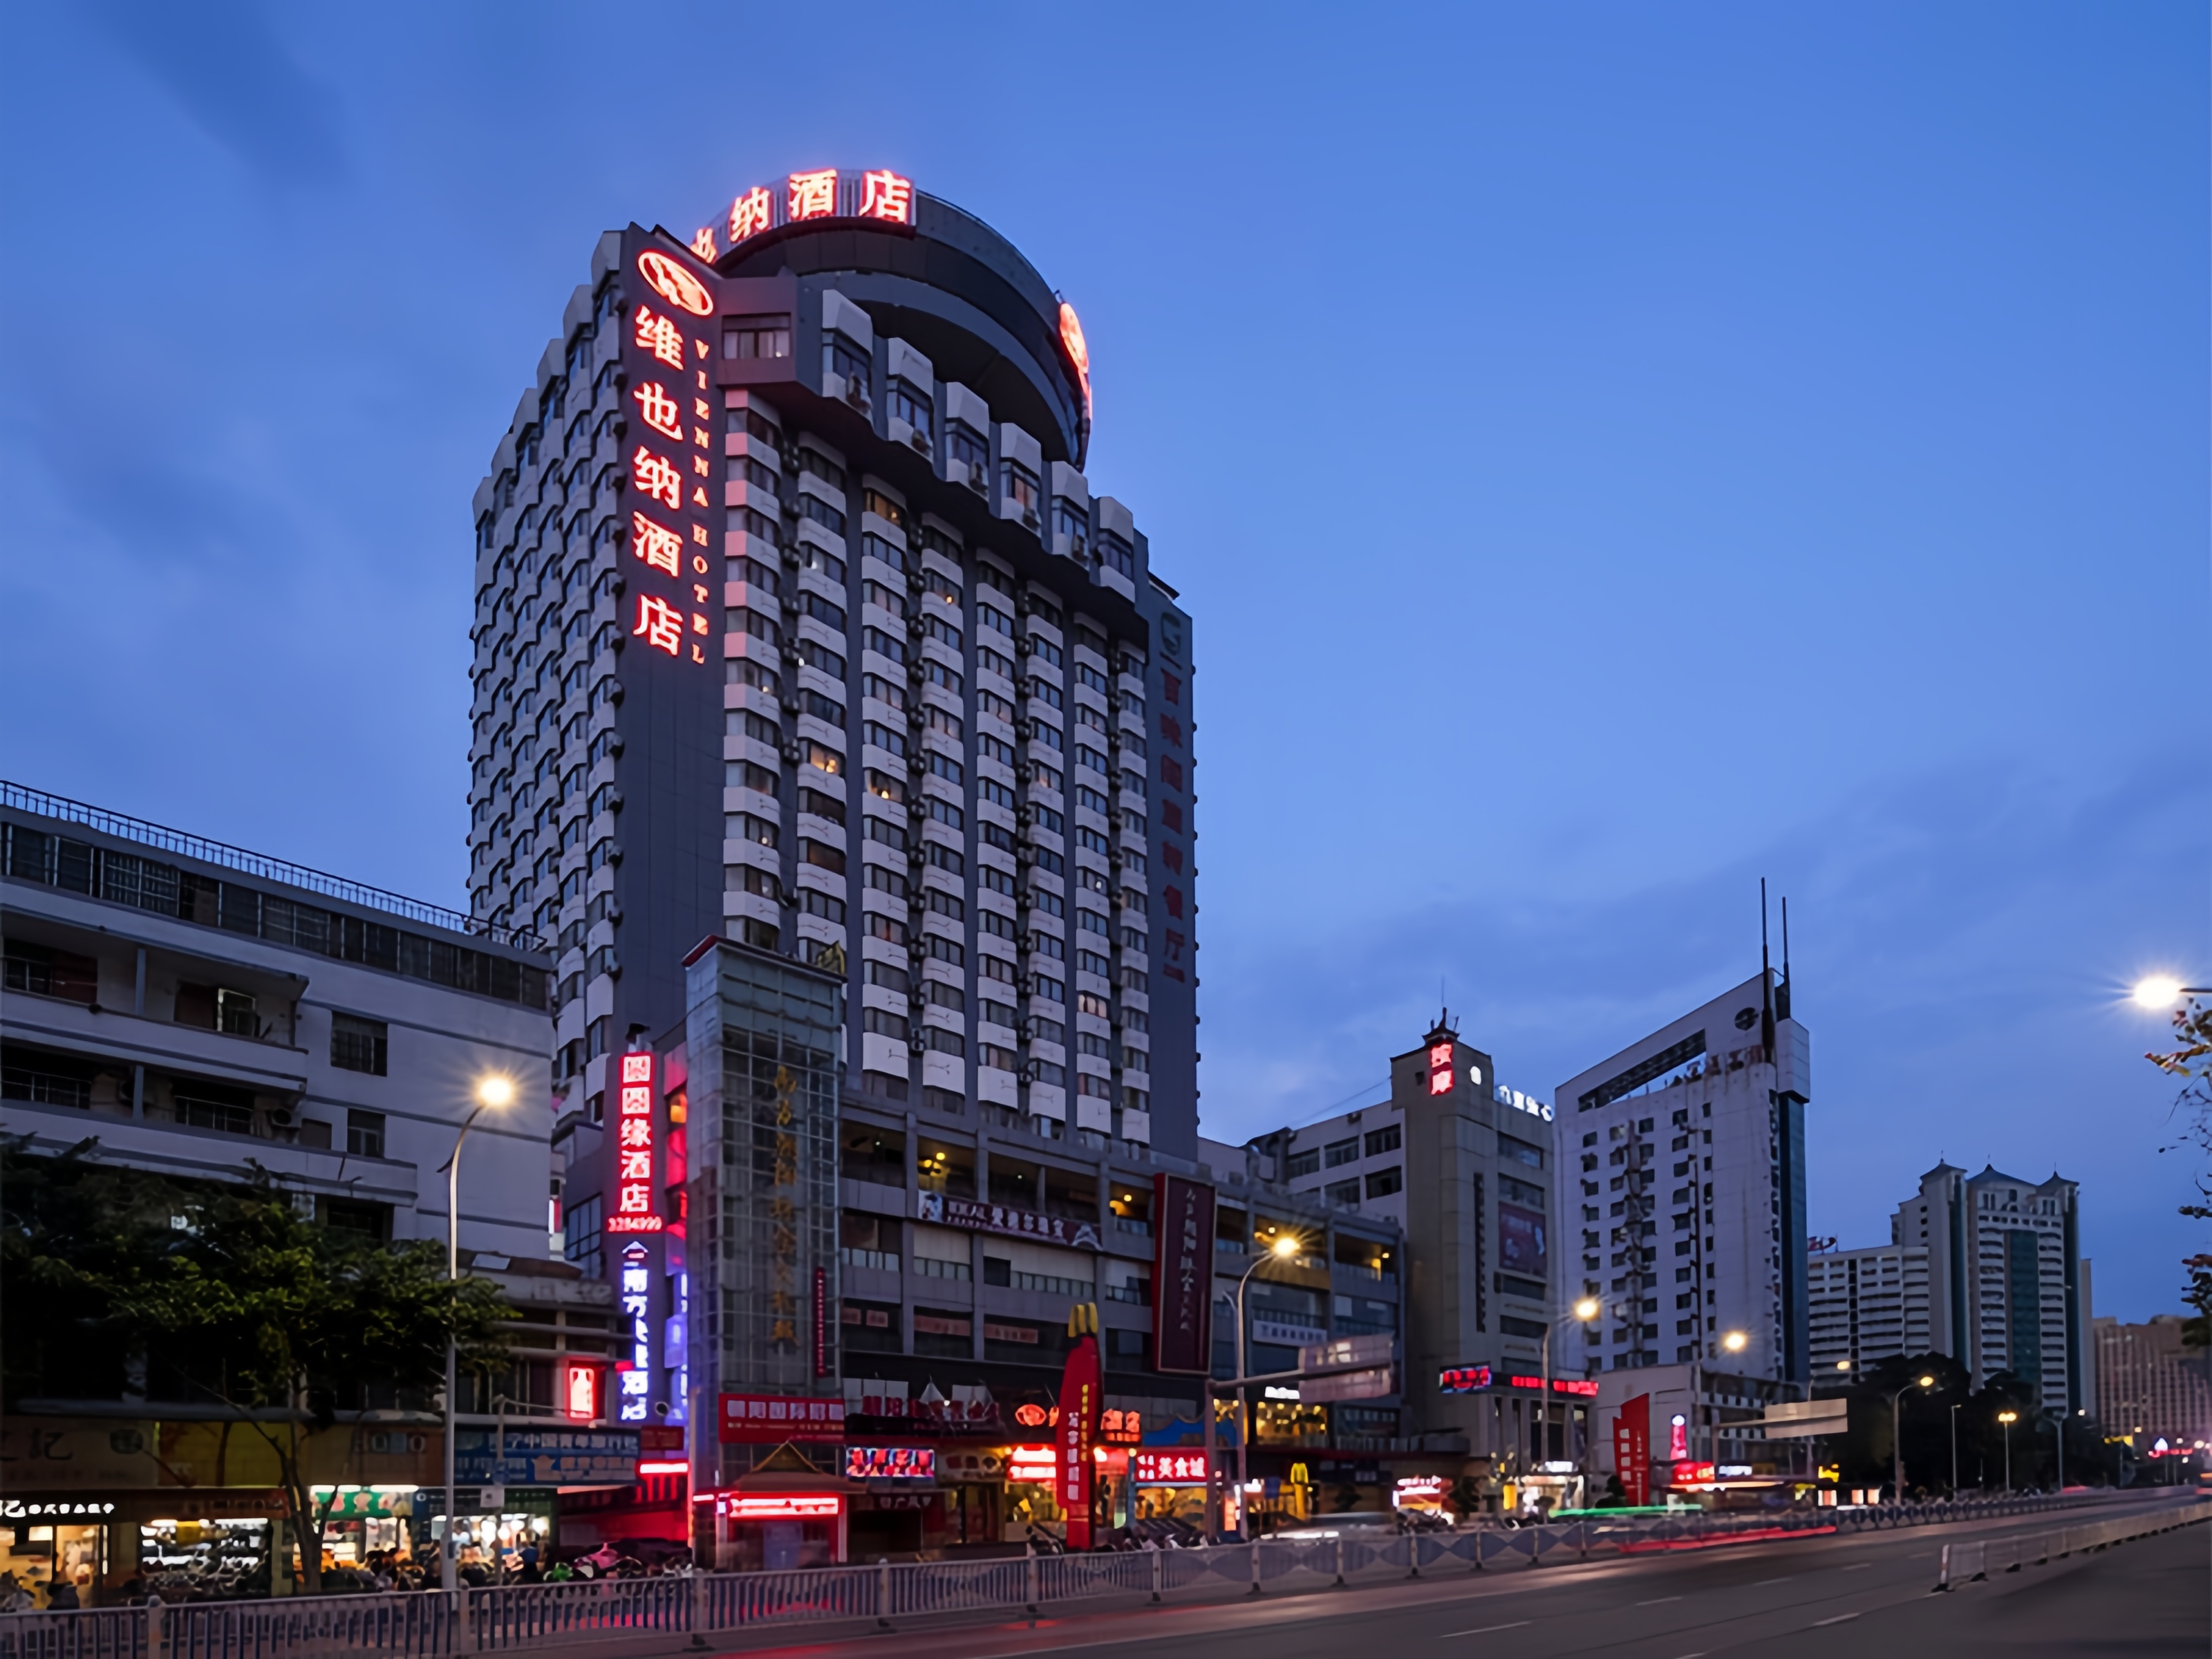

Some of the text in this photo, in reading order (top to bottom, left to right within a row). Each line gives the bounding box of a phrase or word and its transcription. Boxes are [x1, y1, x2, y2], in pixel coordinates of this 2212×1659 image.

[633, 305, 684, 657] 维也纳酒店
[692, 339, 709, 664] VIENNA HOTEL
